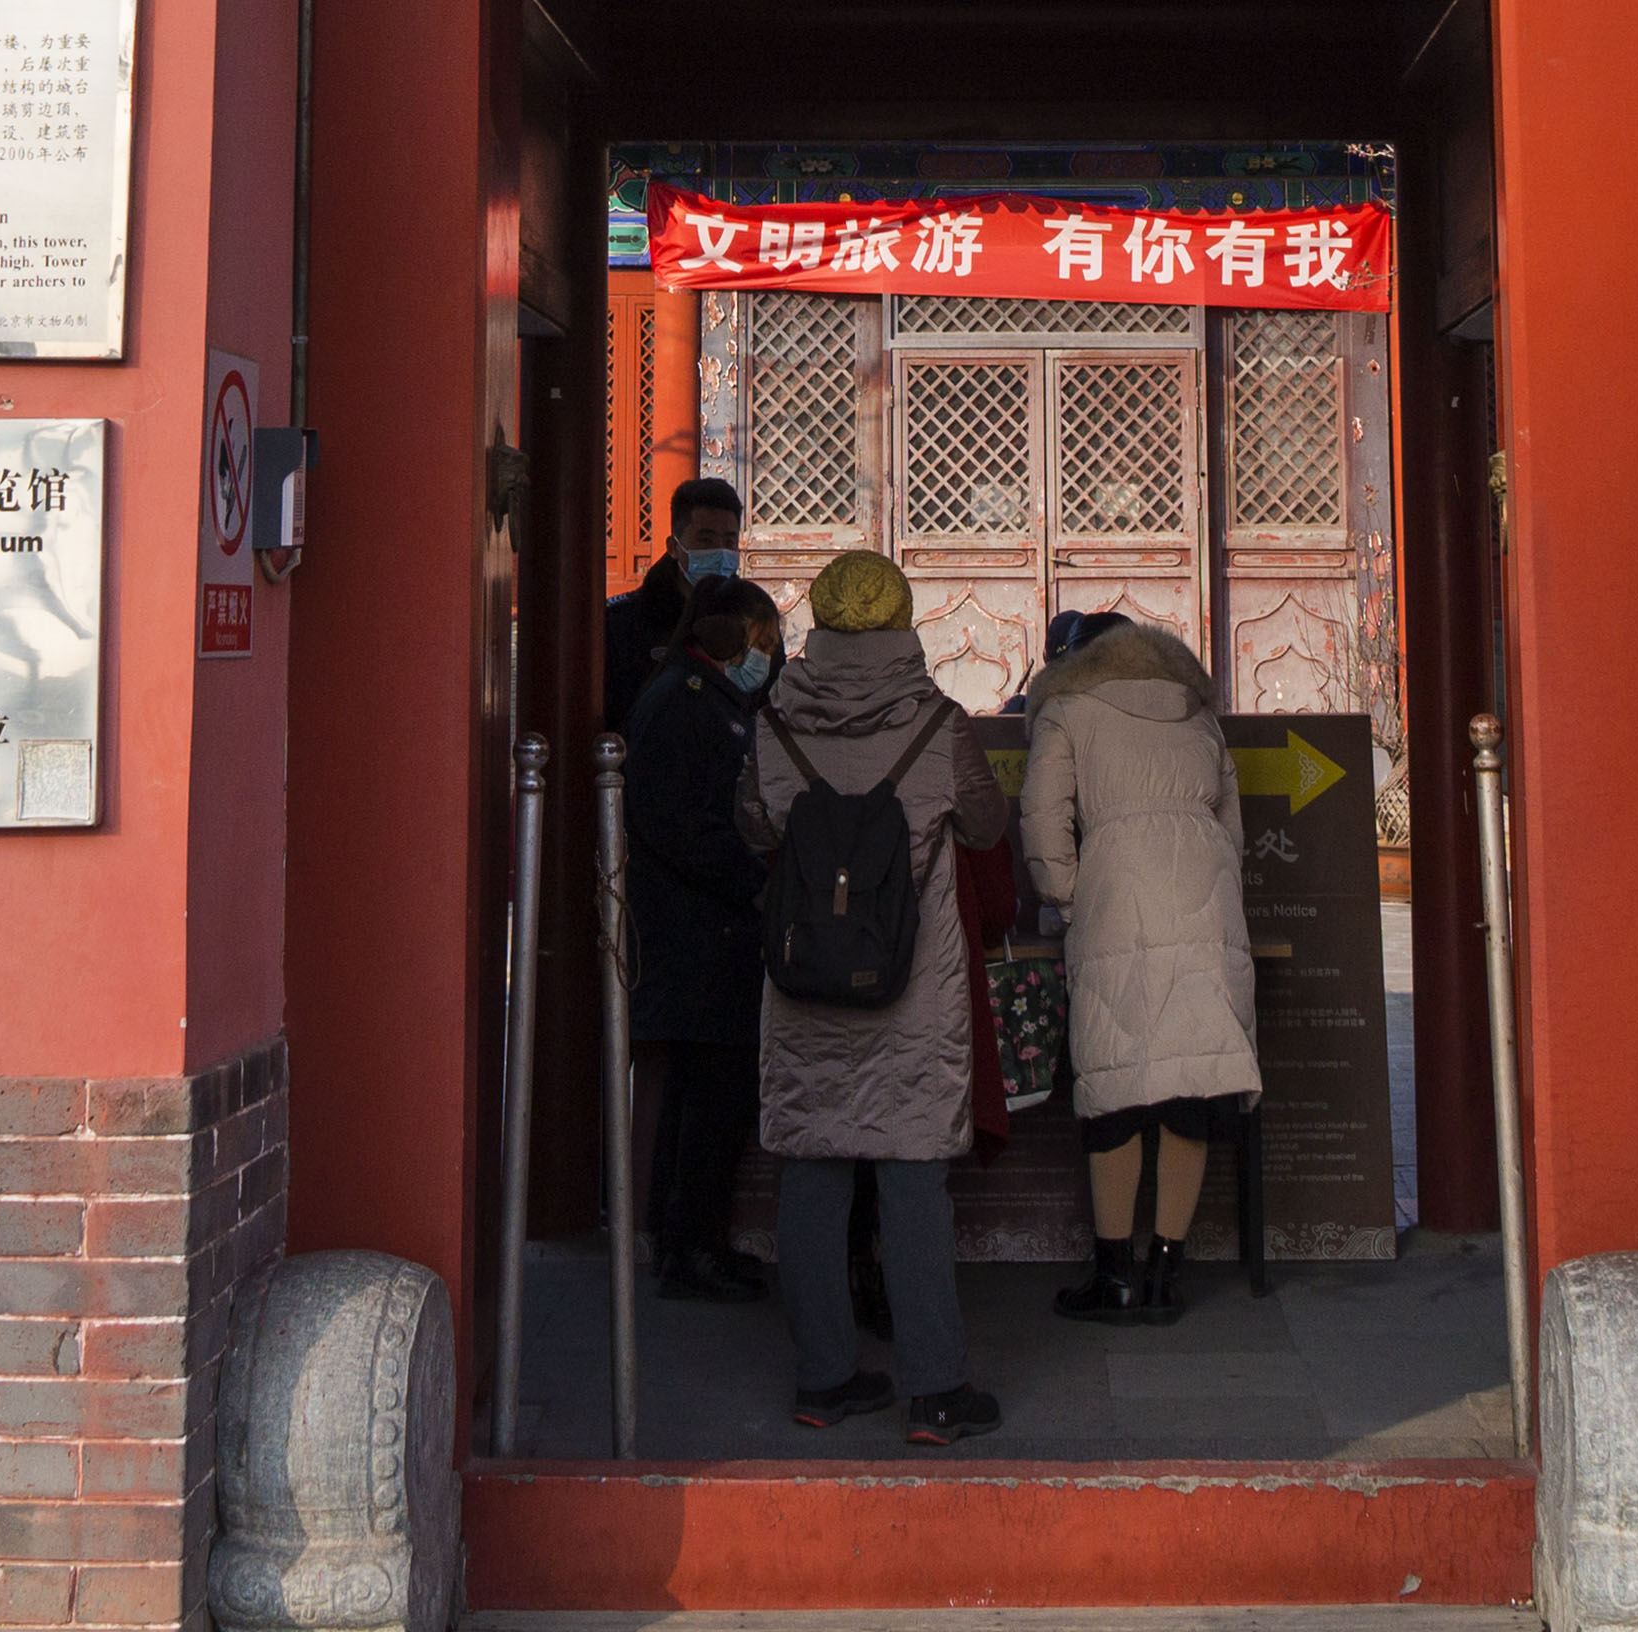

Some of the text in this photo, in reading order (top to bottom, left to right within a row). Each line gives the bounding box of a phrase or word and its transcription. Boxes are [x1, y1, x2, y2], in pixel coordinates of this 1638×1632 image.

[13, 235, 38, 249] this
[44, 236, 88, 250] tower,
[679, 213, 1352, 290] 文明旅游 有你有我
[0, 255, 35, 270] high.
[42, 255, 87, 268] Tower
[12, 275, 66, 288] archers
[72, 276, 86, 288] to
[1273, 903, 1317, 918] Notice
